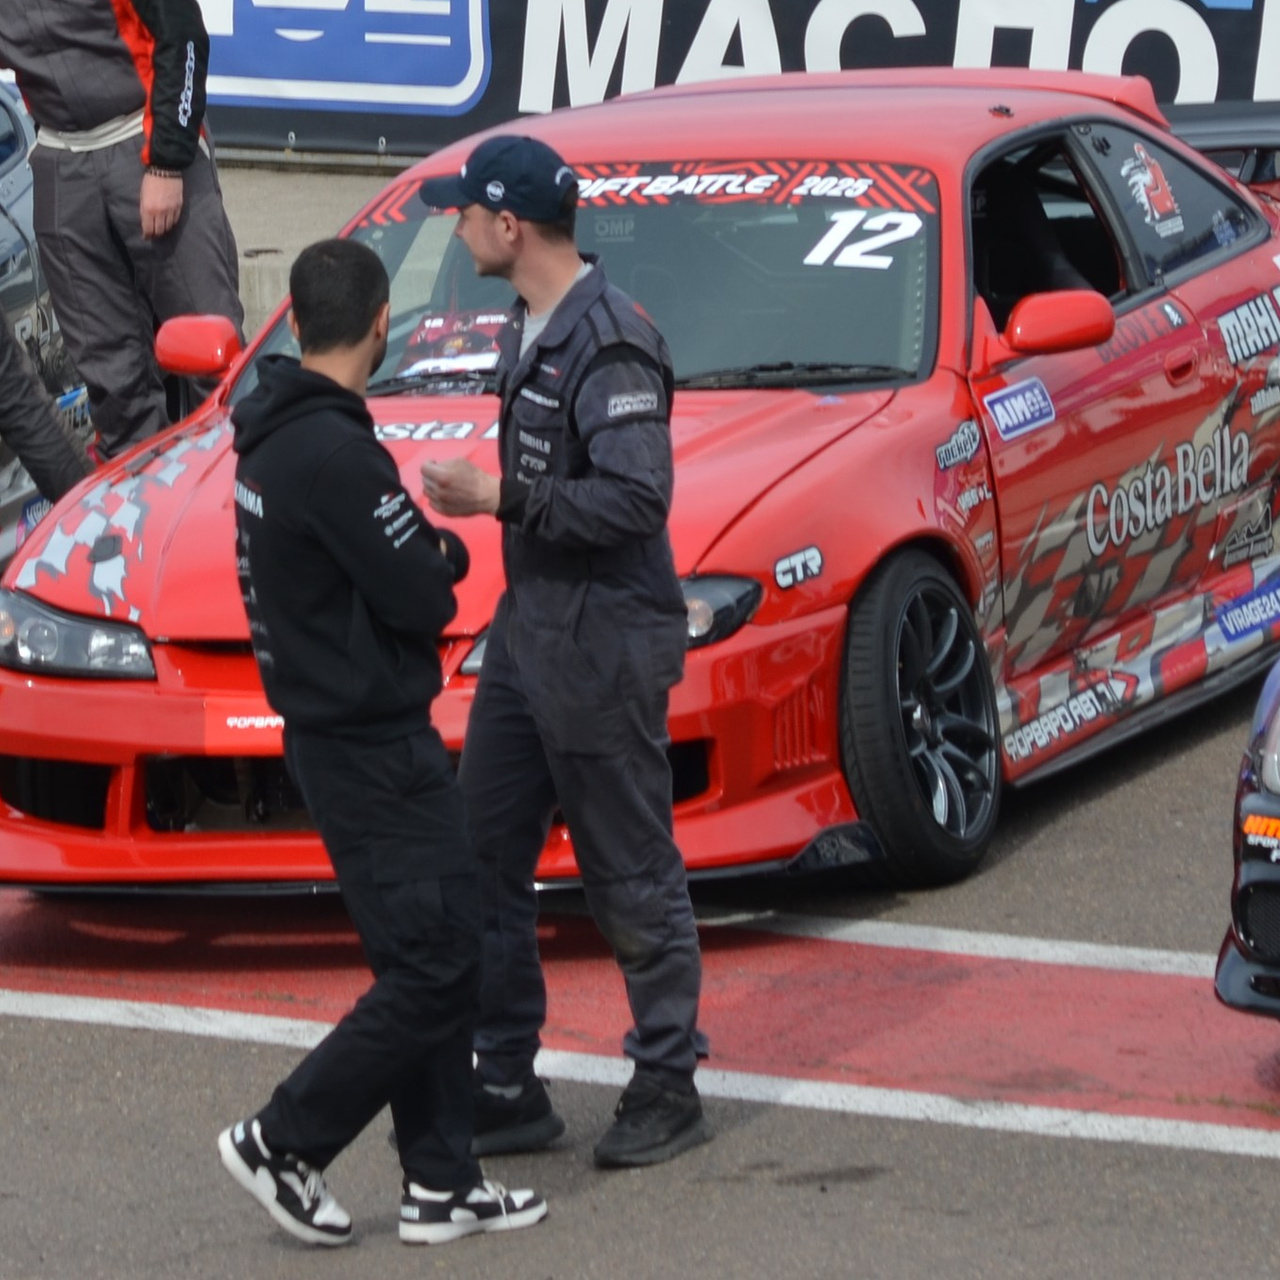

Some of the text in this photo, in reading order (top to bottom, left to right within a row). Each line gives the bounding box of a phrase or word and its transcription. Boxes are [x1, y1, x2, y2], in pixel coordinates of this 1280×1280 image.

[576, 173, 874, 199] RIFT BATTLE 2025
[803, 209, 923, 269] 12
[775, 546, 823, 589] CTR
